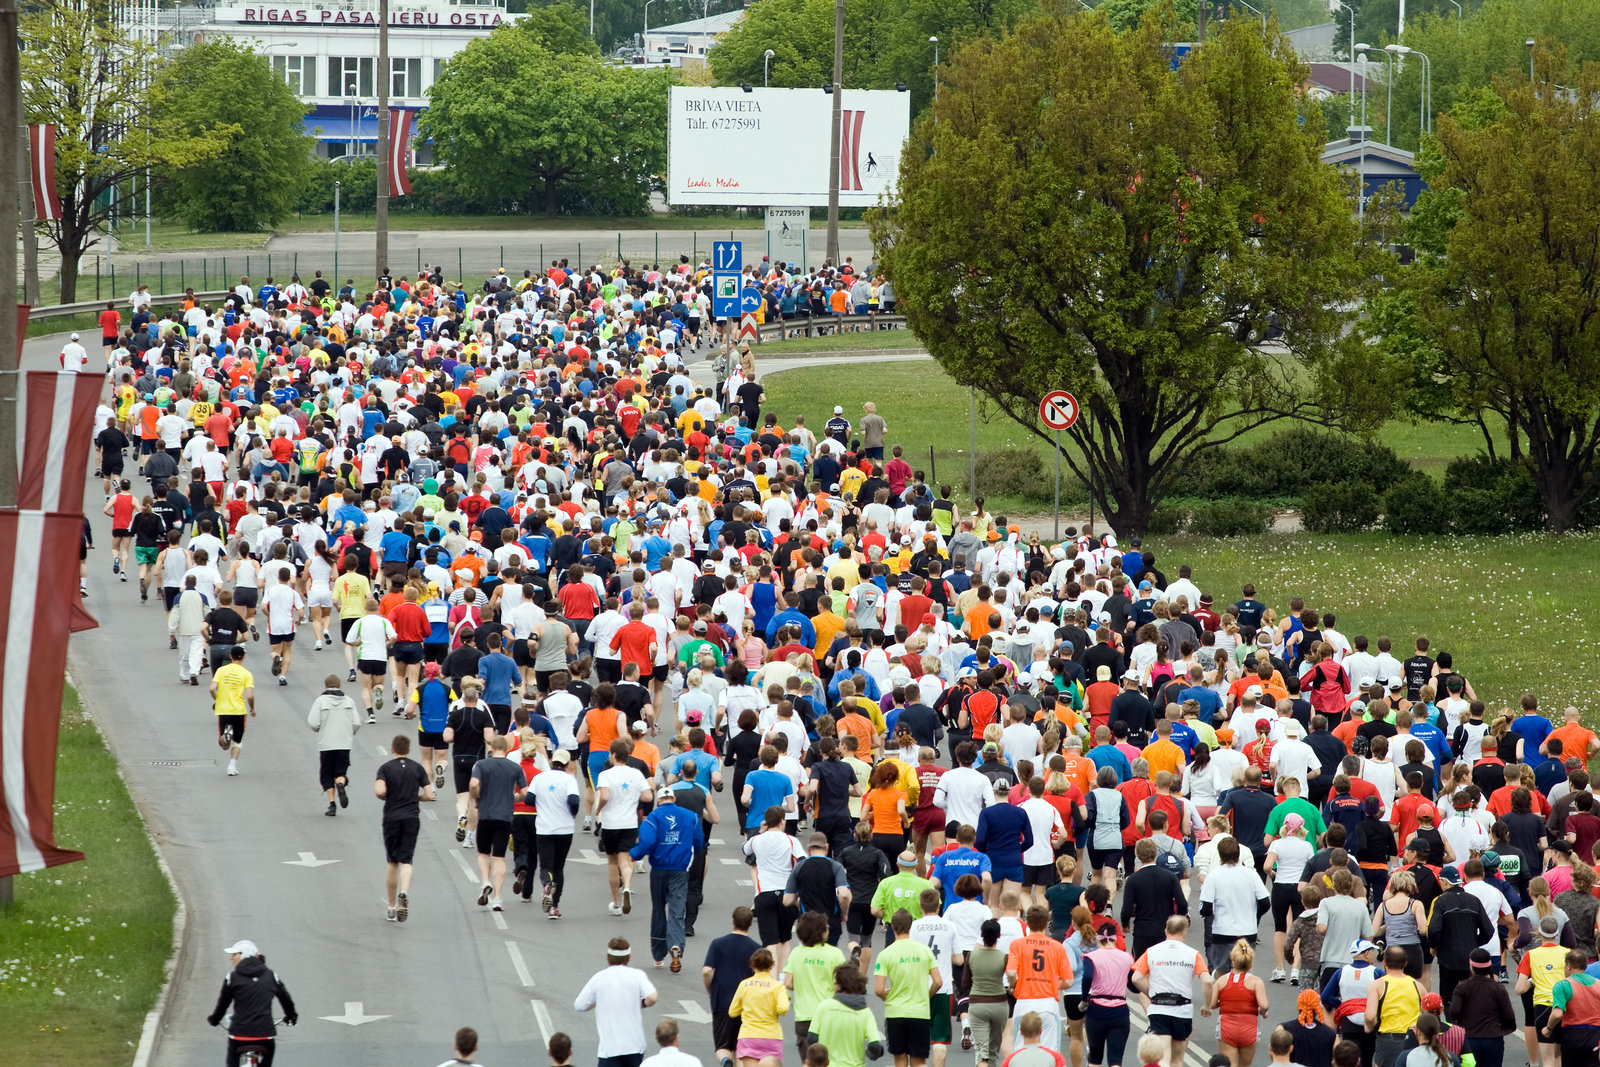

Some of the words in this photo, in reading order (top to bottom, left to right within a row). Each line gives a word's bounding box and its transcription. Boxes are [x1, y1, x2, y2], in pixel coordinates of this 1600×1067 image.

[245, 5, 307, 22] RĪGAS
[321, 10, 439, 25] PASAIERU
[450, 13, 503, 25] OSTA
[685, 98, 723, 112] BRĪVA
[725, 99, 762, 112] VIETA
[711, 118, 761, 130] 67275991
[687, 177, 712, 188] Leader
[715, 177, 740, 188] Media
[769, 209, 805, 217] 67275991
[196, 404, 208, 414] 38
[1499, 860, 1519, 870] 2808
[916, 923, 949, 932] GERRARD
[927, 935, 941, 960] 4
[1031, 948, 1045, 973] 5
[744, 980, 771, 988] LATVIA
